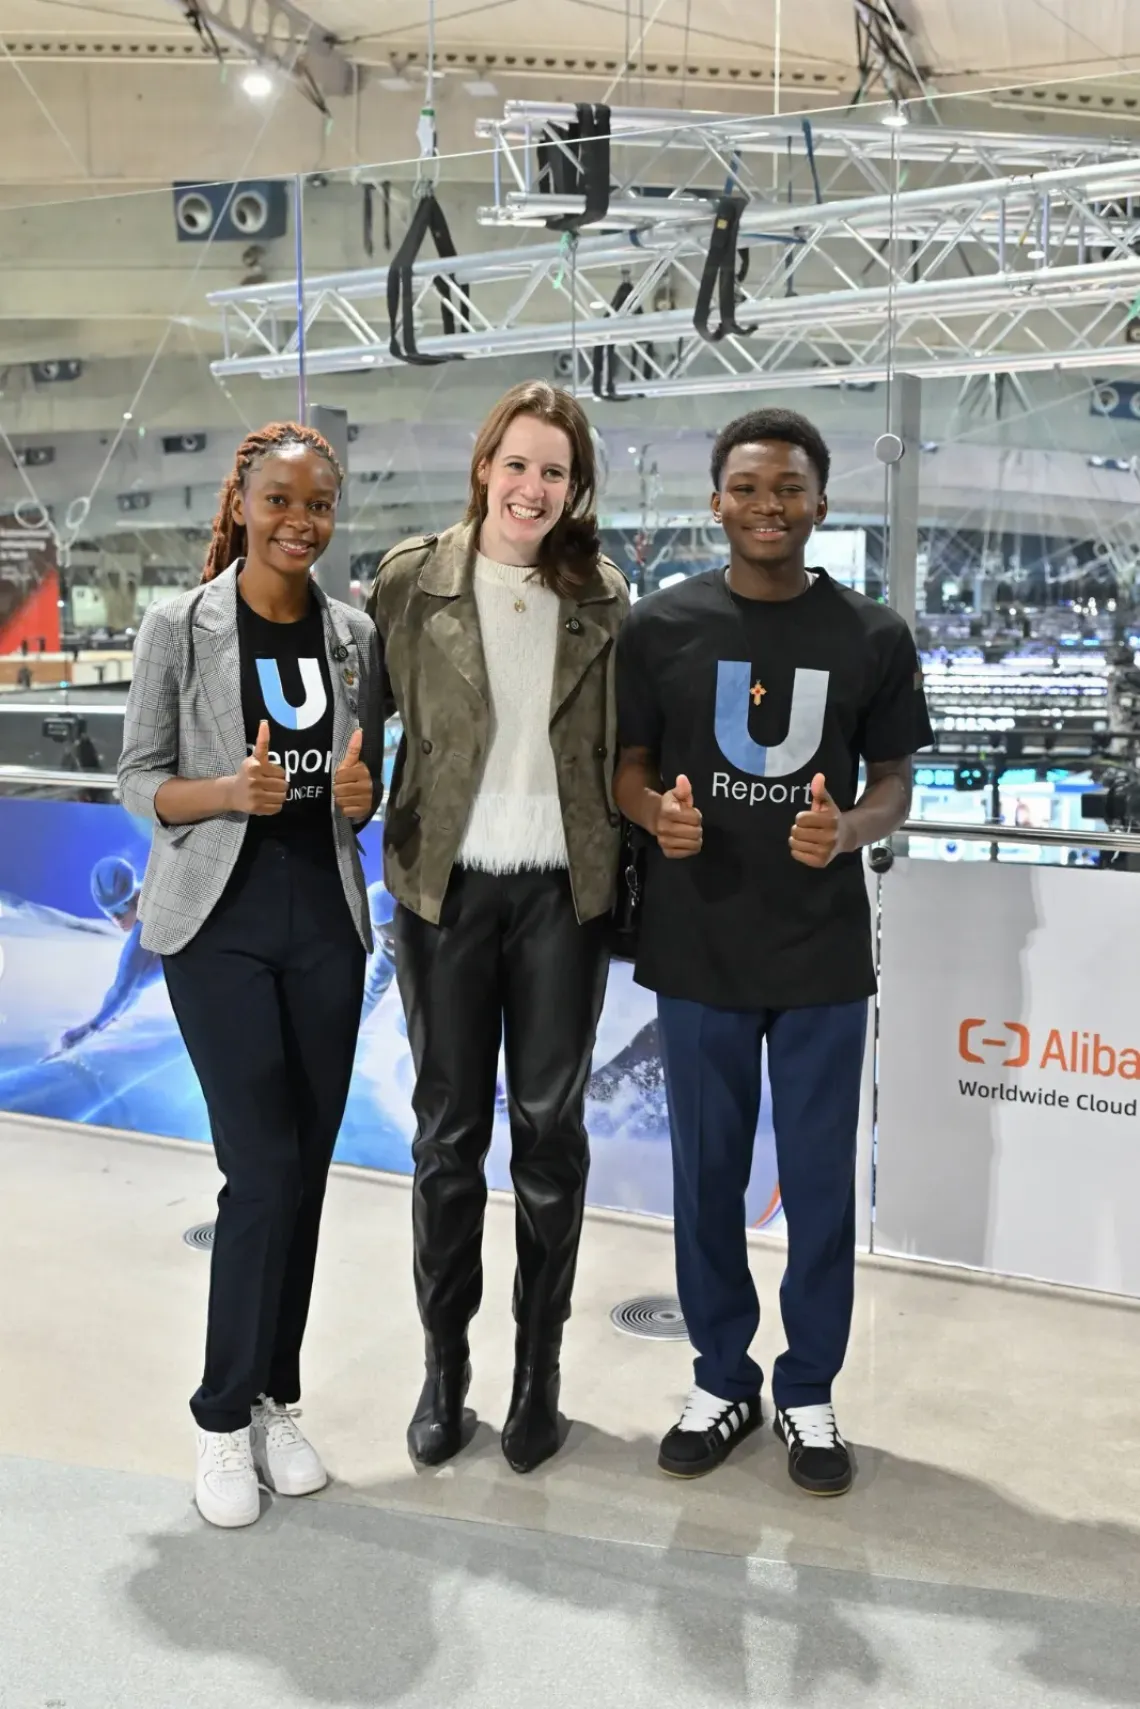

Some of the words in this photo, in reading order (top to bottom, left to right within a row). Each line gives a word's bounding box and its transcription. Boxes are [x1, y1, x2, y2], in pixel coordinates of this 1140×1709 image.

[255, 657, 327, 730] U
[714, 659, 830, 777] U
[711, 771, 812, 806] Report
[1039, 1028, 1140, 1080] Aliba
[958, 1079, 1070, 1108] Worldwide
[1076, 1093, 1137, 1116] Cloud
